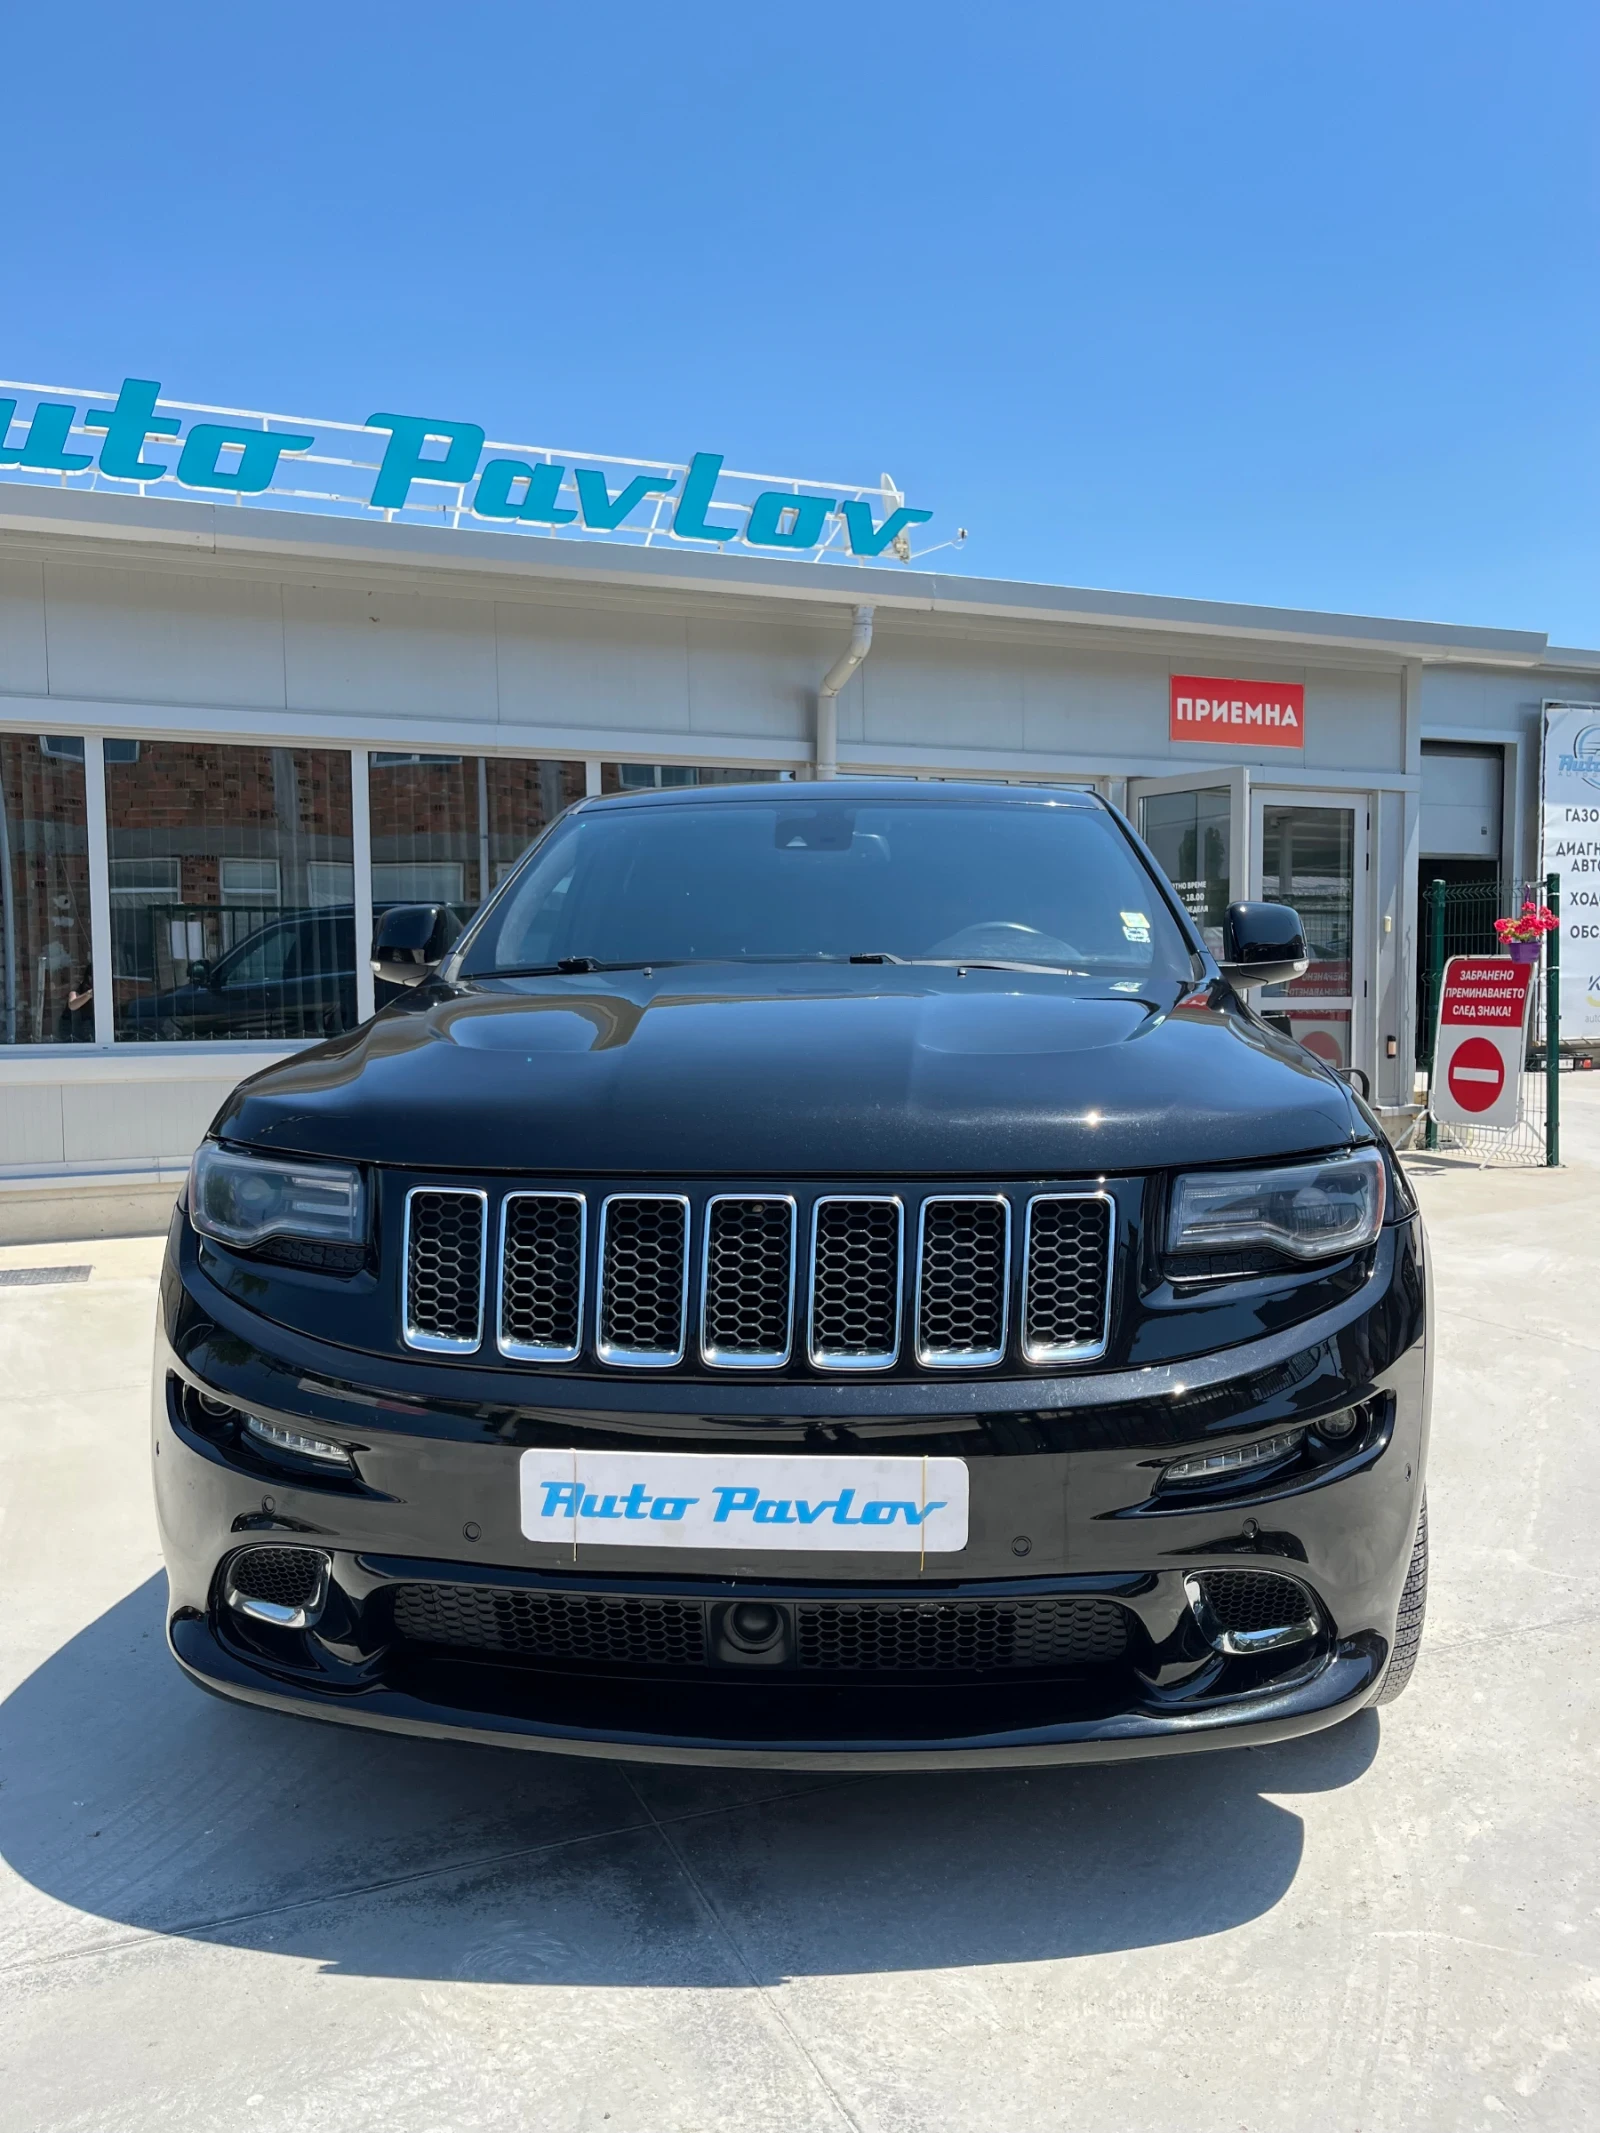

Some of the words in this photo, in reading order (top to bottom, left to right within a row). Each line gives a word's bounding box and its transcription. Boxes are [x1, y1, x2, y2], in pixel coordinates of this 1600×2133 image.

[1177, 697, 1298, 727] ПРИЕМНА
[1570, 892, 1600, 906] ХОД
[1570, 925, 1600, 938] ОБС
[1460, 970, 1515, 981] ЗАБРАНЕНО
[1446, 987, 1525, 999] ПРЕМИНАВАНЕТО
[1453, 1005, 1476, 1017] СЛЕД
[1477, 1005, 1512, 1017] ЗНАКА!
[540, 1481, 700, 1521] Auto
